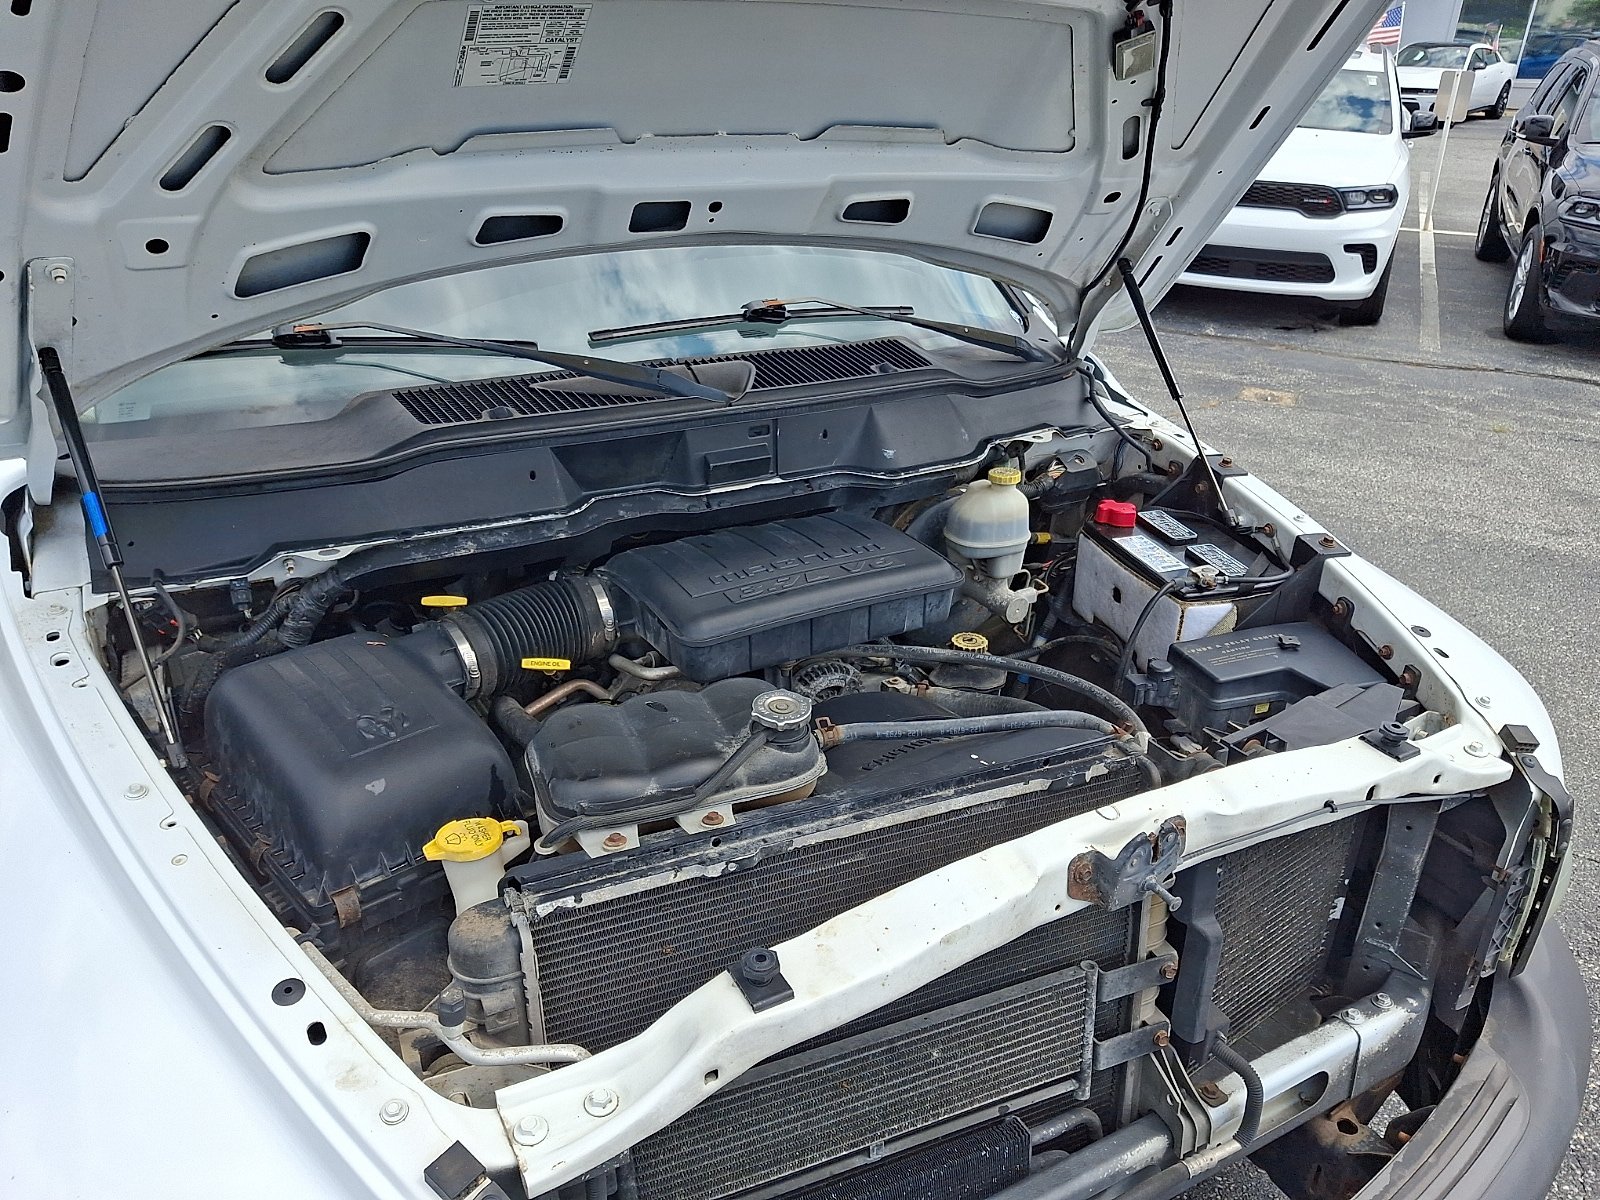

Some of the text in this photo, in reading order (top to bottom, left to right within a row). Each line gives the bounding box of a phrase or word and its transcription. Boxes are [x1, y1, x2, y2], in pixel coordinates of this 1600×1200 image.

[1224, 638, 1250, 647] RELAY
[462, 820, 484, 847] FLUID ONLY
[474, 820, 492, 842] WASHER
